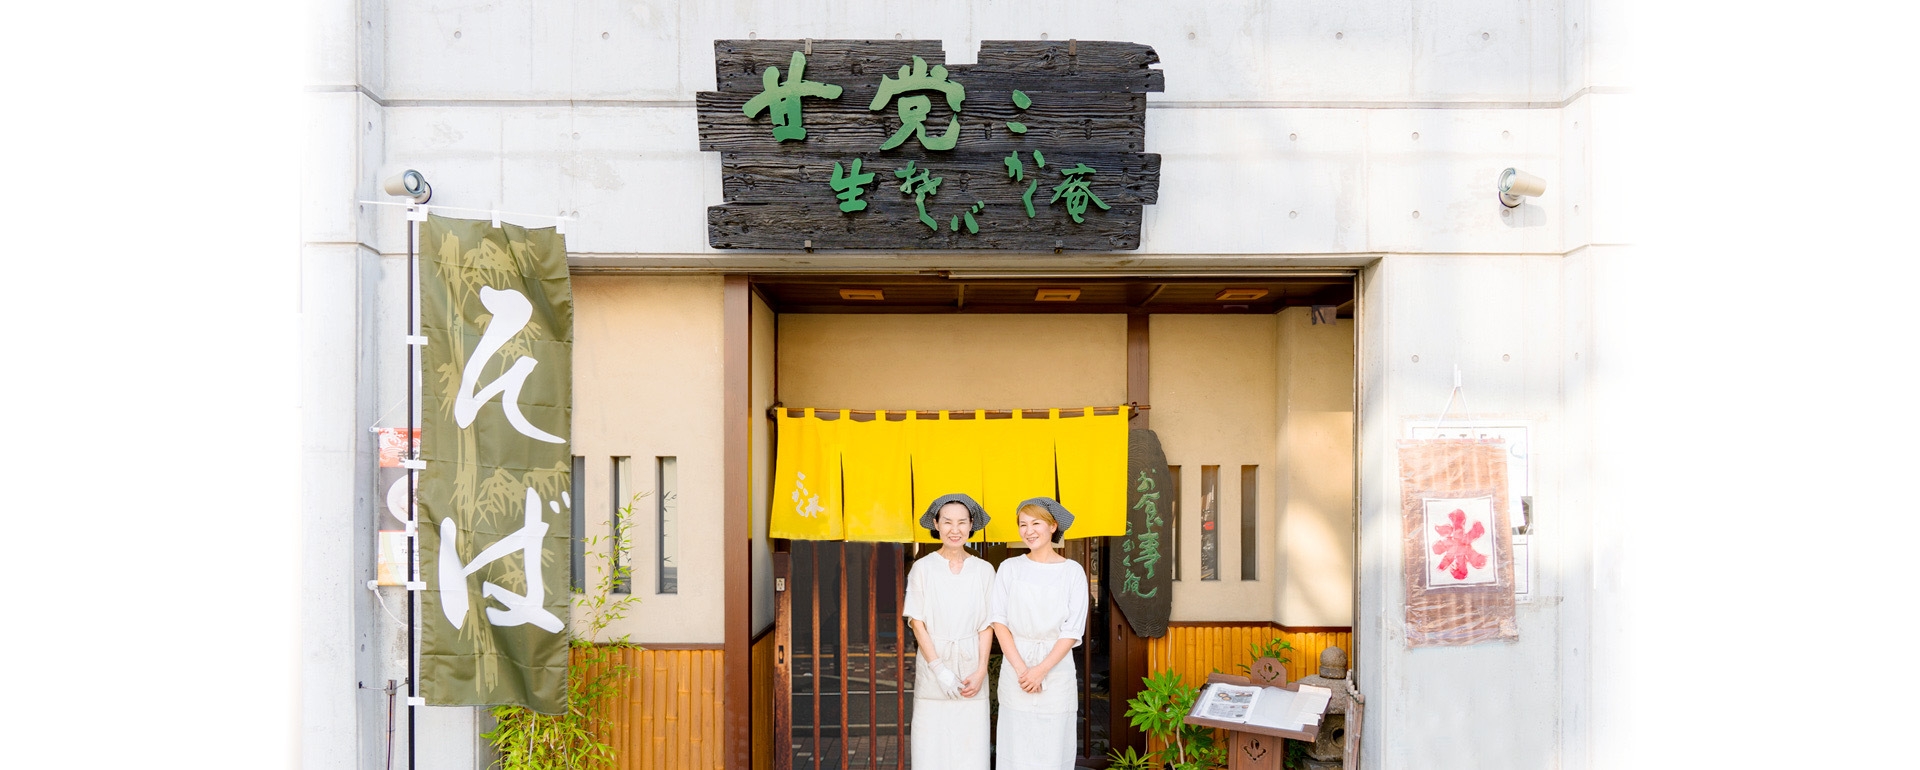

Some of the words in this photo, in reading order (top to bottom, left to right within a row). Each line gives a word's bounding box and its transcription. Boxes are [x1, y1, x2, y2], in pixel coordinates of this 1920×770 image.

[438, 285, 571, 635] そば
[1133, 468, 1164, 580] お食事
[1431, 508, 1488, 580] 氷
